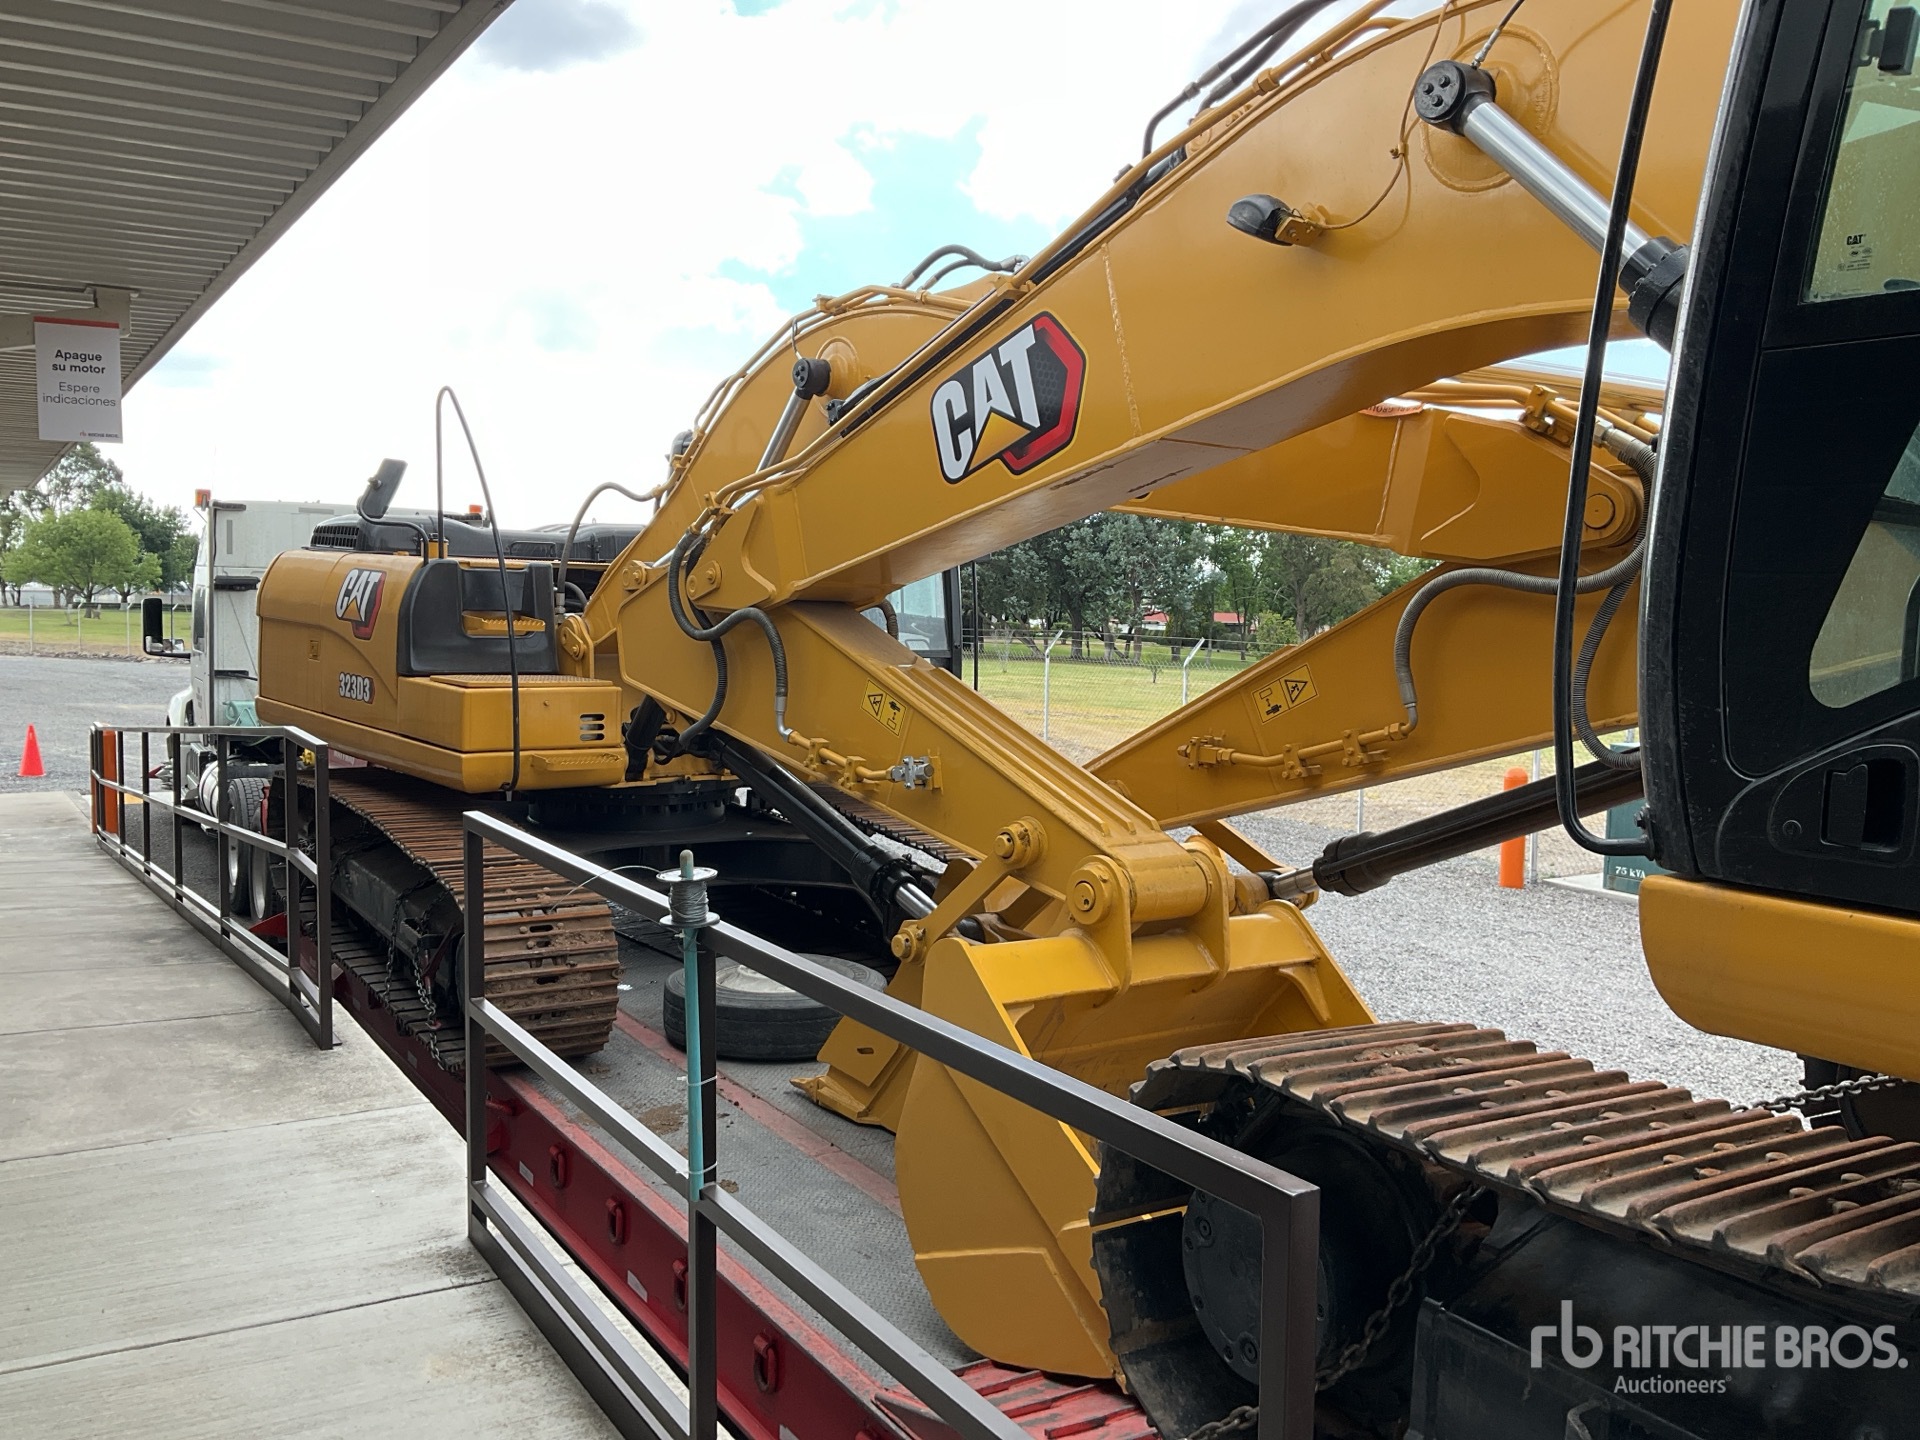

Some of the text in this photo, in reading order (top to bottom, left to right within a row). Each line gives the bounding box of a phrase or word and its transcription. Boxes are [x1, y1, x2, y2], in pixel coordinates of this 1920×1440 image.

[1846, 234, 1863, 245] CAT
[55, 349, 102, 362] Apague
[52, 363, 106, 374] su motor
[59, 381, 100, 394] Espere
[42, 392, 116, 407] indicaciones
[932, 323, 1041, 480] CAT
[336, 568, 382, 622] CAT
[339, 672, 371, 703] 323D3
[1615, 865, 1646, 879] 75 kVA
